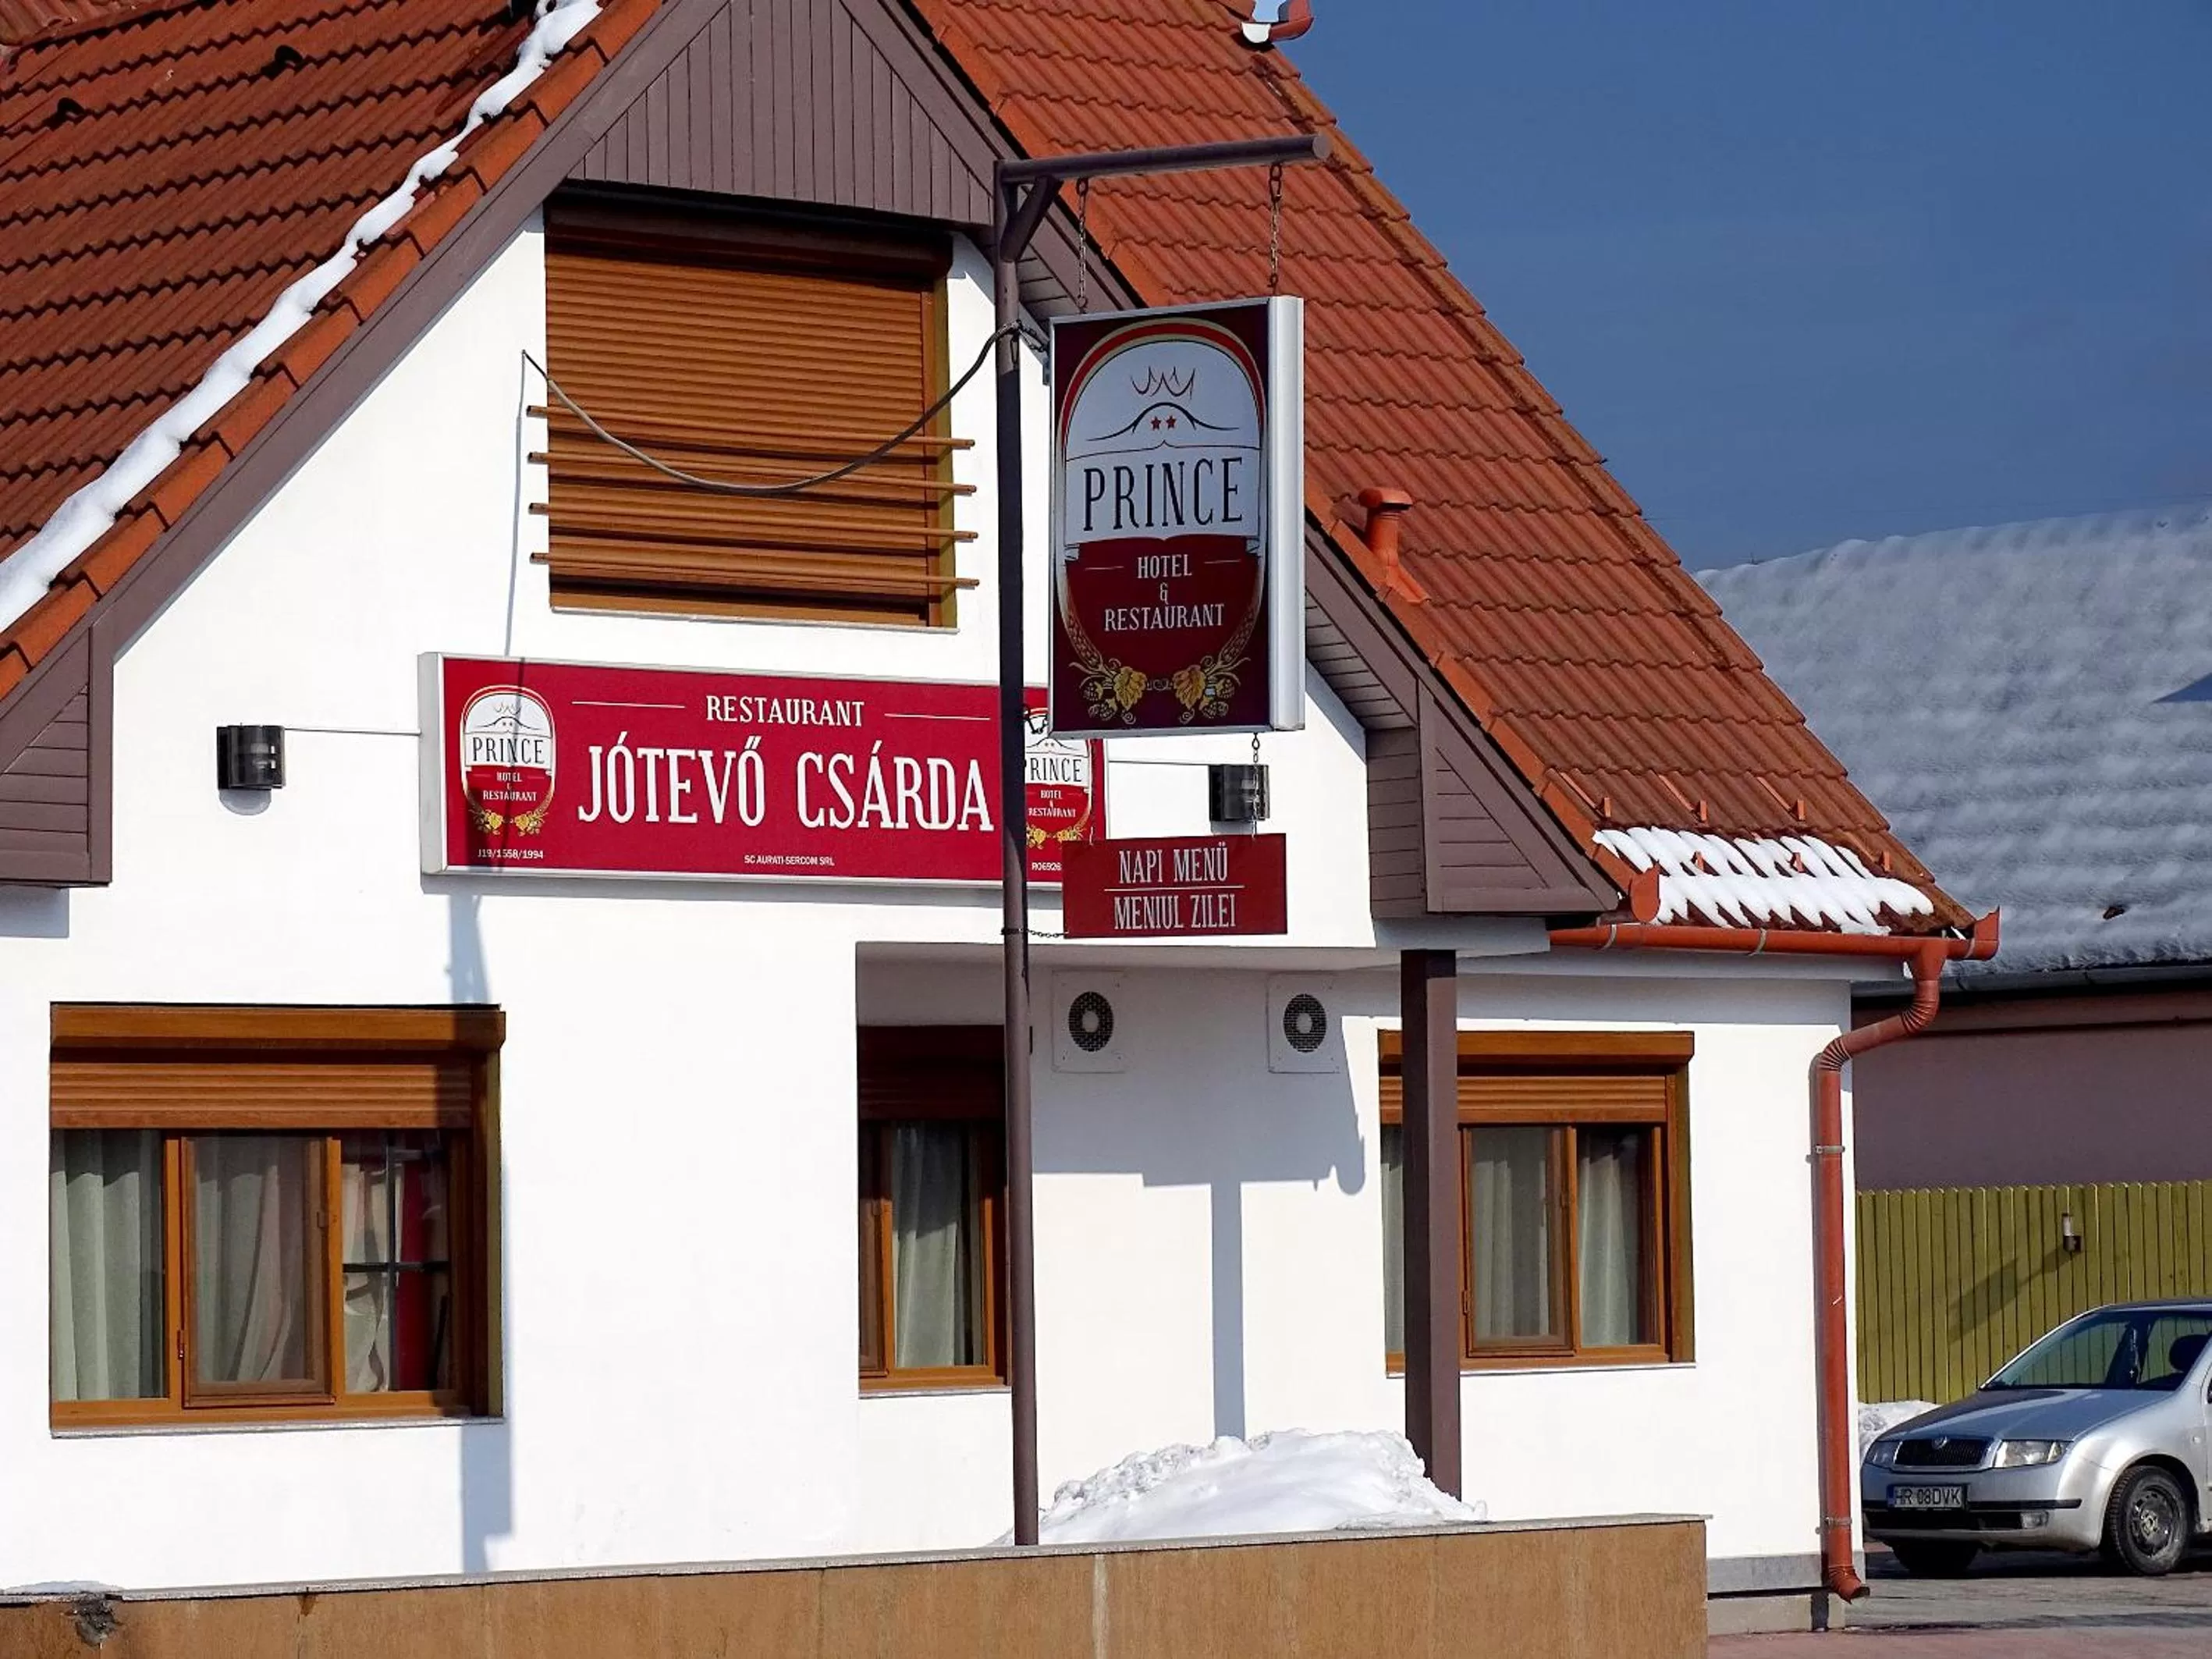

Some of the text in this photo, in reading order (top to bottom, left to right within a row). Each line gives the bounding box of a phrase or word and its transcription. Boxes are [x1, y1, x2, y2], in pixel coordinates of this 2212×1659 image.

[1084, 456, 1242, 531] PRINCE
[1137, 554, 1193, 579] HOTEL
[1159, 582, 1169, 605] &
[1104, 603, 1225, 632] RESTAURANT
[705, 695, 865, 727] RESTAURANT
[472, 737, 545, 764] PRINCE
[496, 771, 522, 782] HOTEL
[577, 731, 996, 832] JÓTEVŐ CSÁRDA
[1024, 757, 1082, 782] RINCE
[482, 790, 538, 802] RESTAURANT
[1040, 789, 1062, 800] HOTEL
[1028, 807, 1077, 818] RESTAURANT
[744, 854, 756, 864] SC
[818, 855, 836, 866] SRL
[1119, 841, 1228, 884] NAPI MENÜ
[1113, 893, 1237, 930] MENIUL ZILEI
[1894, 1488, 1912, 1504] HR
